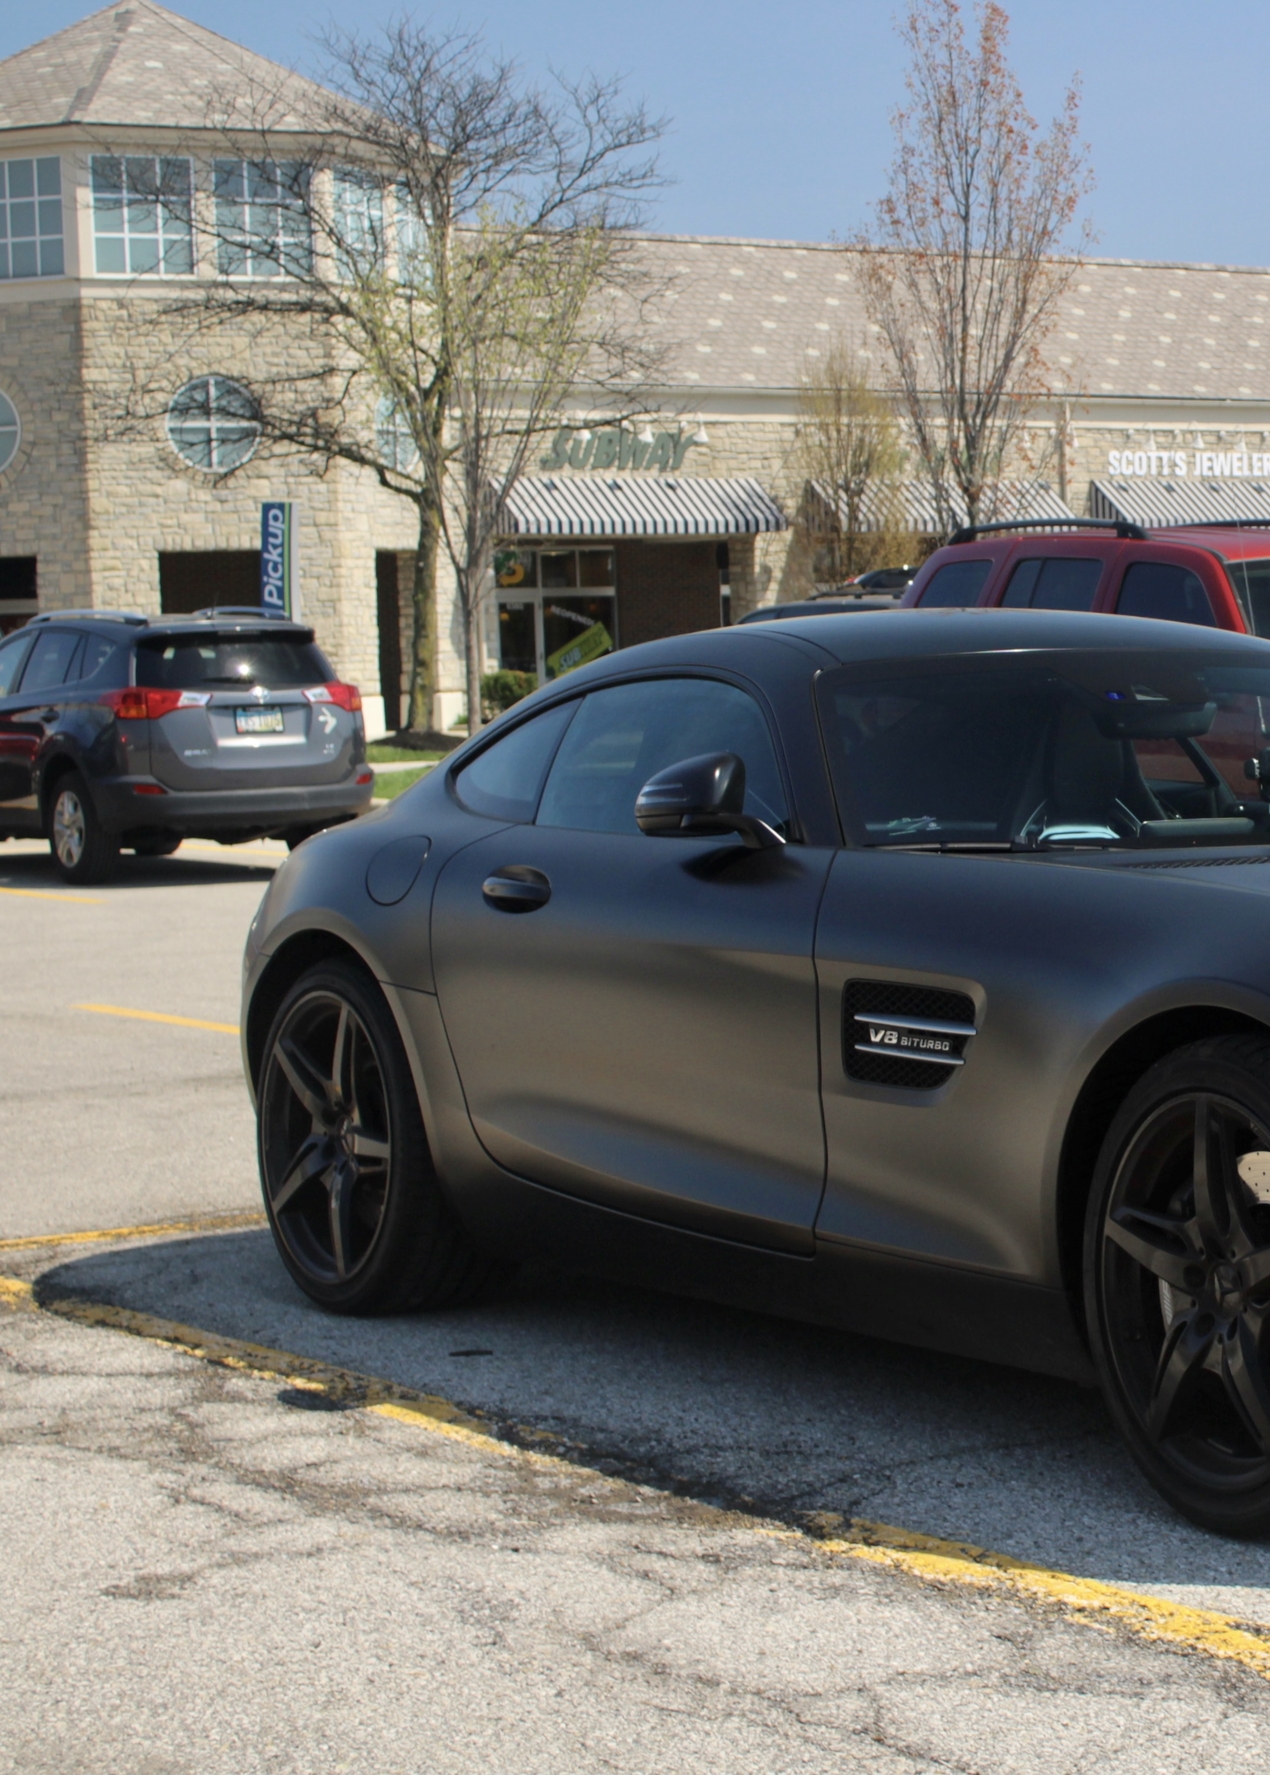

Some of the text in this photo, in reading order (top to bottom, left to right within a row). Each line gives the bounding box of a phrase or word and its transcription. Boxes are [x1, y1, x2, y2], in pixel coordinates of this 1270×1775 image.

[540, 429, 701, 470] SUBWAY
[1108, 450, 1187, 477] SCOTT'S
[263, 507, 285, 607] Pickup
[869, 1028, 950, 1051] V8 BITURBO
